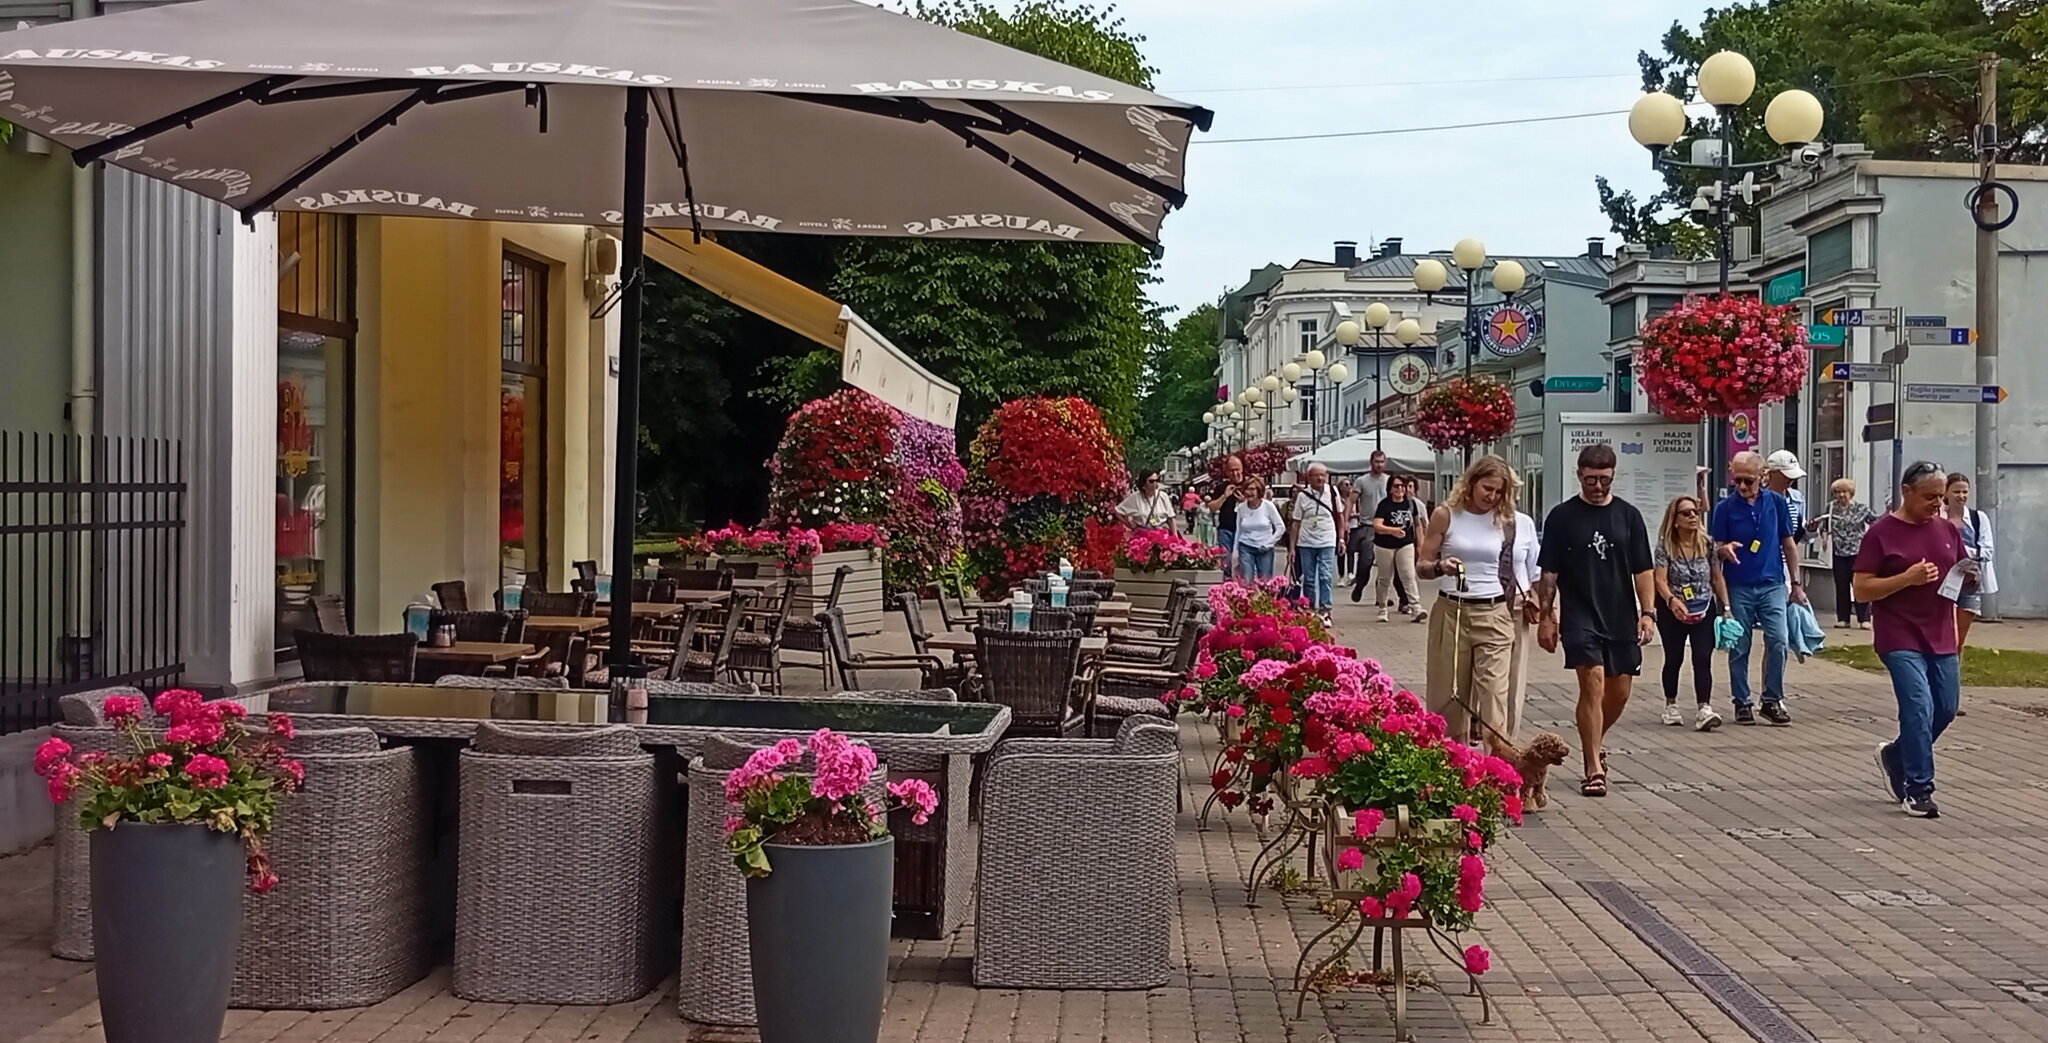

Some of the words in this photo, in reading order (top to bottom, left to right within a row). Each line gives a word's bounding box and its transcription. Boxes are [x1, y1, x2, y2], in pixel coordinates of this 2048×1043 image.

[0, 48, 226, 69] AUSKAS
[406, 61, 673, 85] BAUSKAS
[850, 78, 1115, 102] BAUSKAS
[1484, 302, 1532, 321] KLONAIKA
[1571, 429, 1603, 438] LIELĀKIE
